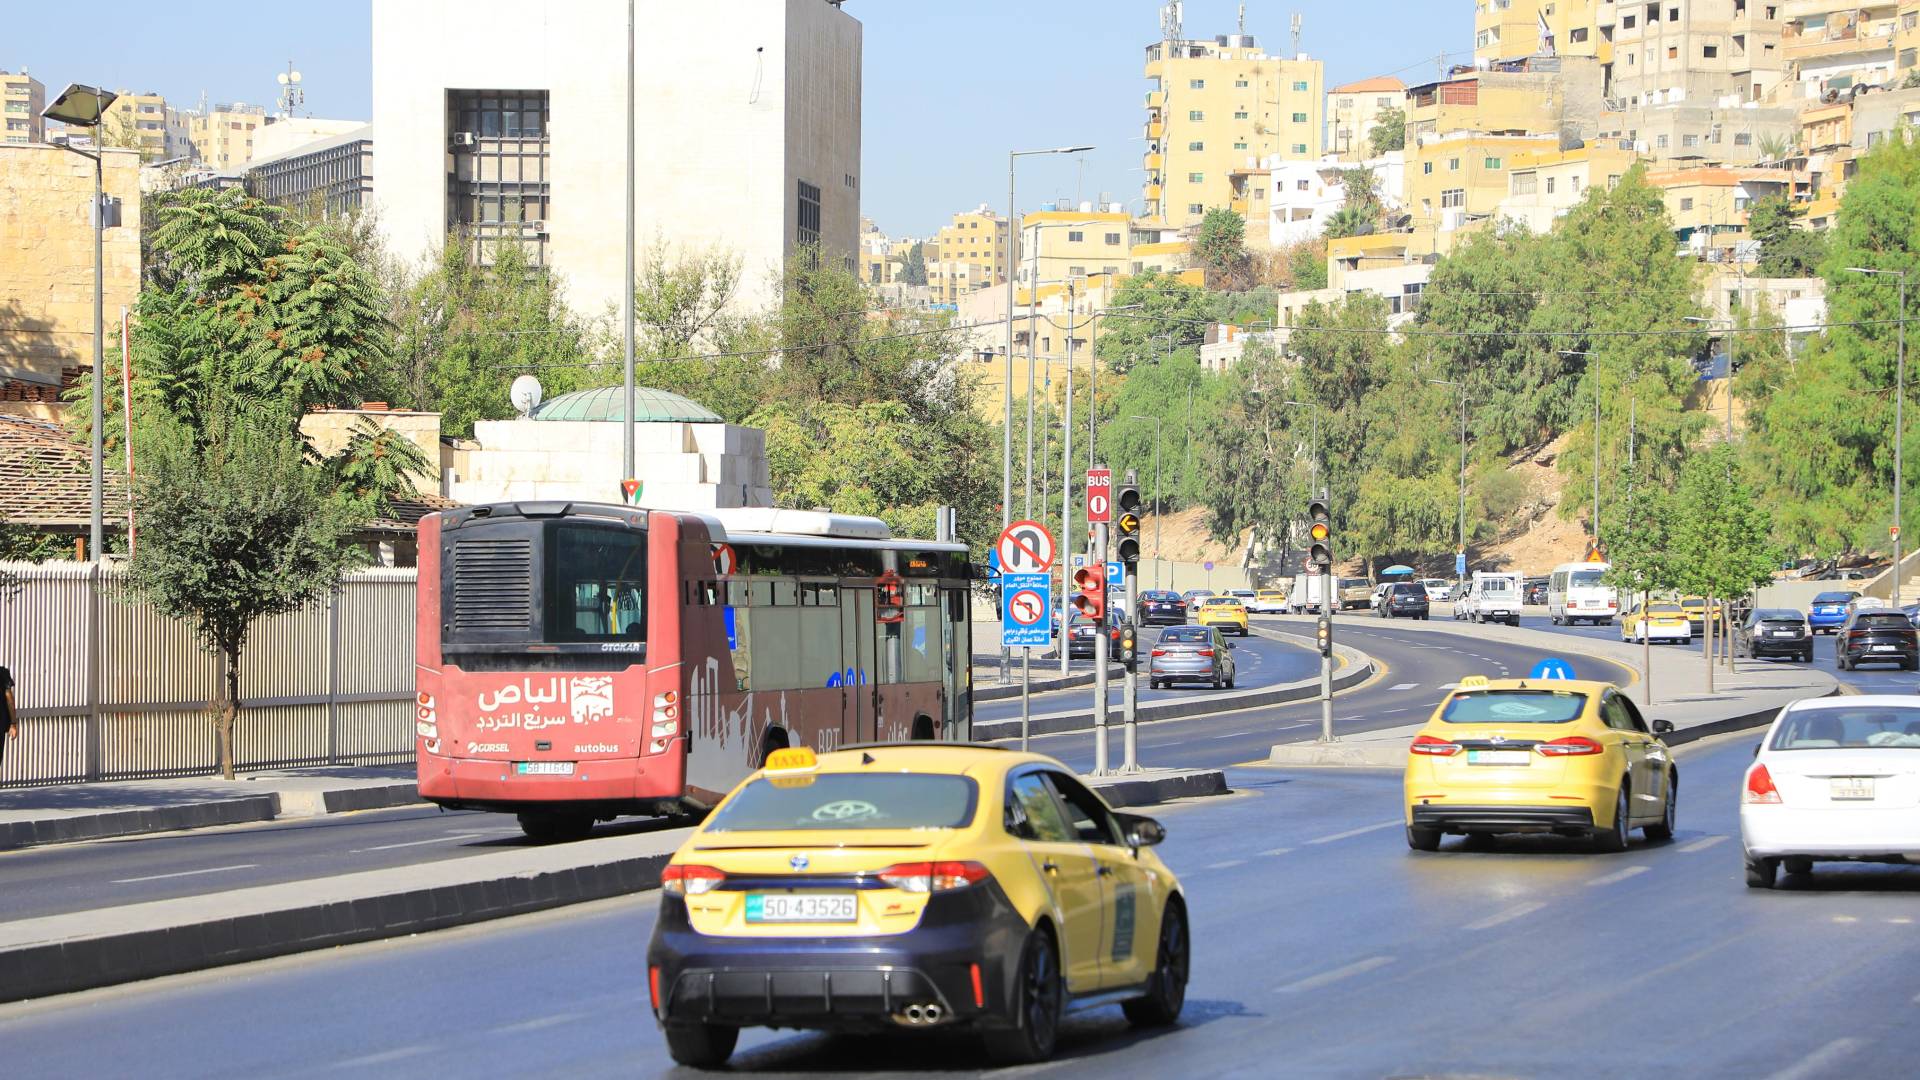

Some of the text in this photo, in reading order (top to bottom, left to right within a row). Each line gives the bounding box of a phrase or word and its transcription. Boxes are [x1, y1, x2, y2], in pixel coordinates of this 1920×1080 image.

[1088, 475, 1109, 487] BUS
[1076, 558, 1082, 566] P
[1107, 565, 1119, 582] P
[601, 643, 640, 652] OTOKAR
[478, 677, 567, 712] الباص
[476, 712, 566, 732] سريع التردد
[574, 743, 619, 753] autobus
[770, 755, 805, 768] TAXI
